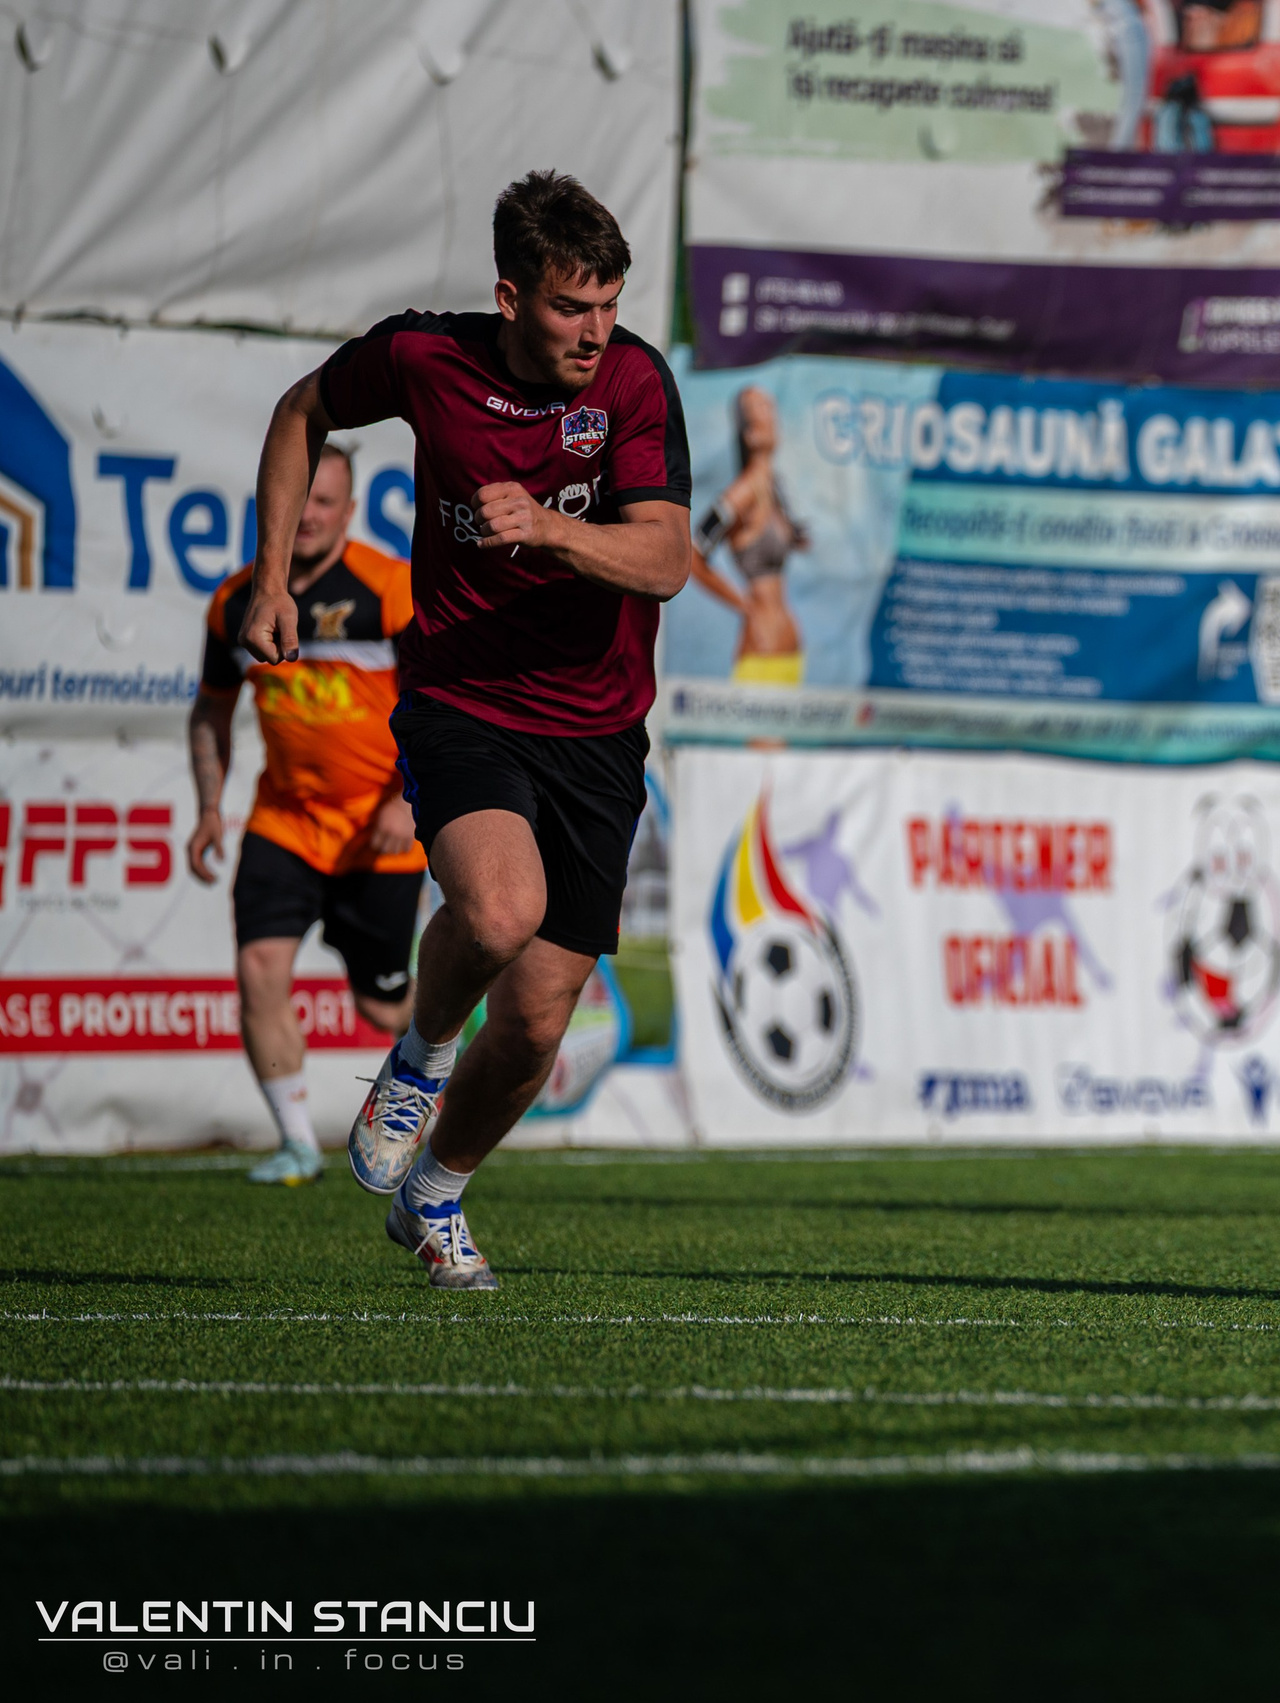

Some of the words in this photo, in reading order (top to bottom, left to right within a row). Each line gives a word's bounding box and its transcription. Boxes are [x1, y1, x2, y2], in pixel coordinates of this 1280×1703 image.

[486, 395, 566, 417] GIVOVA
[565, 431, 605, 446] STREET
[905, 815, 1114, 893] PARTENER
[942, 931, 1085, 1009] OFICIAL
[60, 990, 241, 1049] PROTECȚIE
